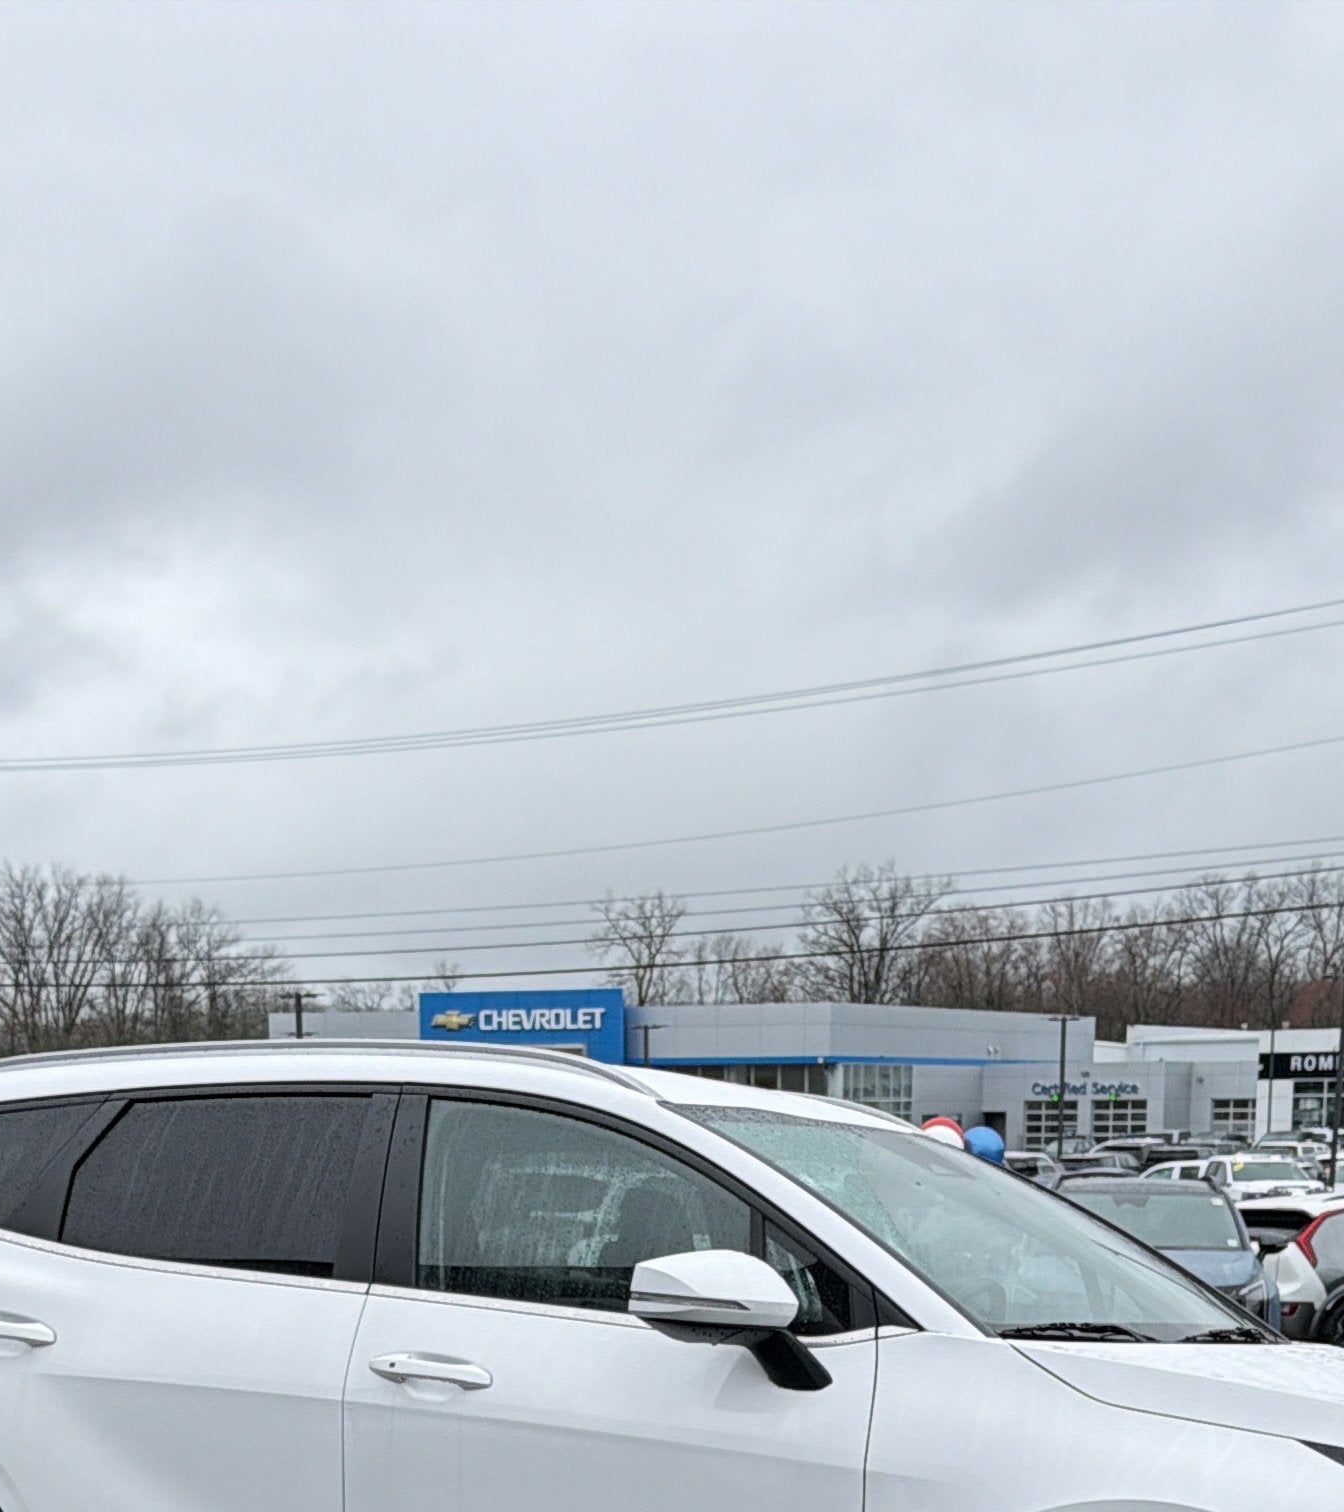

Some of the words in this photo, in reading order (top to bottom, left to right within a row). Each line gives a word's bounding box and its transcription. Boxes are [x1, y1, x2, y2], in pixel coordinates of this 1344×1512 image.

[478, 1007, 606, 1031] CHEVROLET
[1032, 1081, 1087, 1095] Certied
[1092, 1081, 1139, 1095] Service
